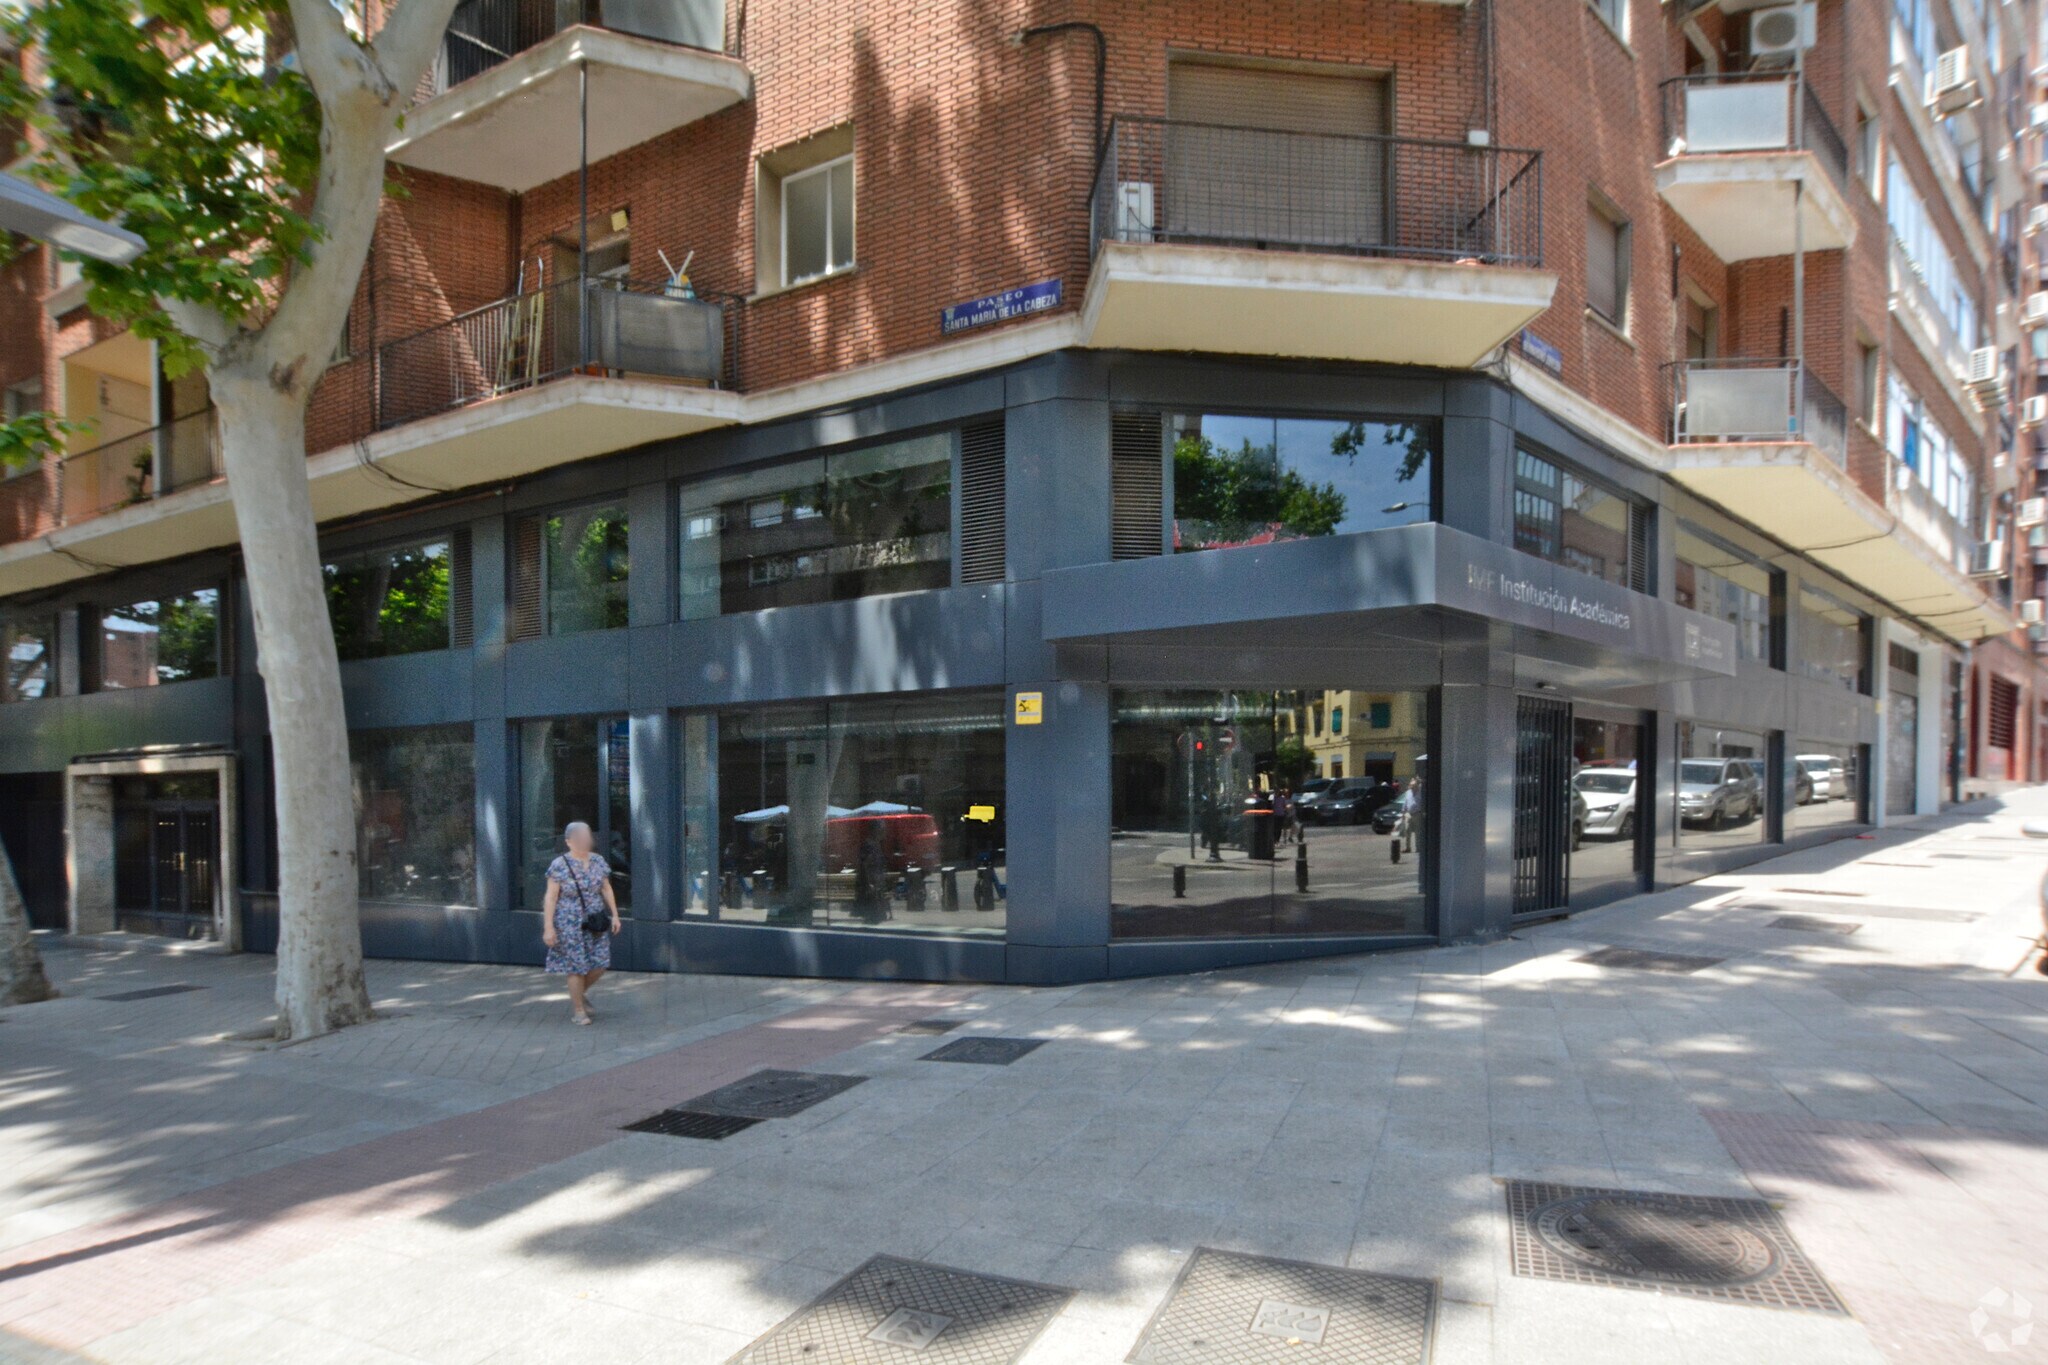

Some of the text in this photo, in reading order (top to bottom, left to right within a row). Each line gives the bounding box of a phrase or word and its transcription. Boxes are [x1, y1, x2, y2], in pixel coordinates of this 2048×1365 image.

[944, 294, 1057, 332] SANTA MARIA DE LA CABEZA
[978, 290, 1024, 309] PASEO
[1500, 574, 1568, 614] Institución
[1570, 596, 1630, 630] Académica
